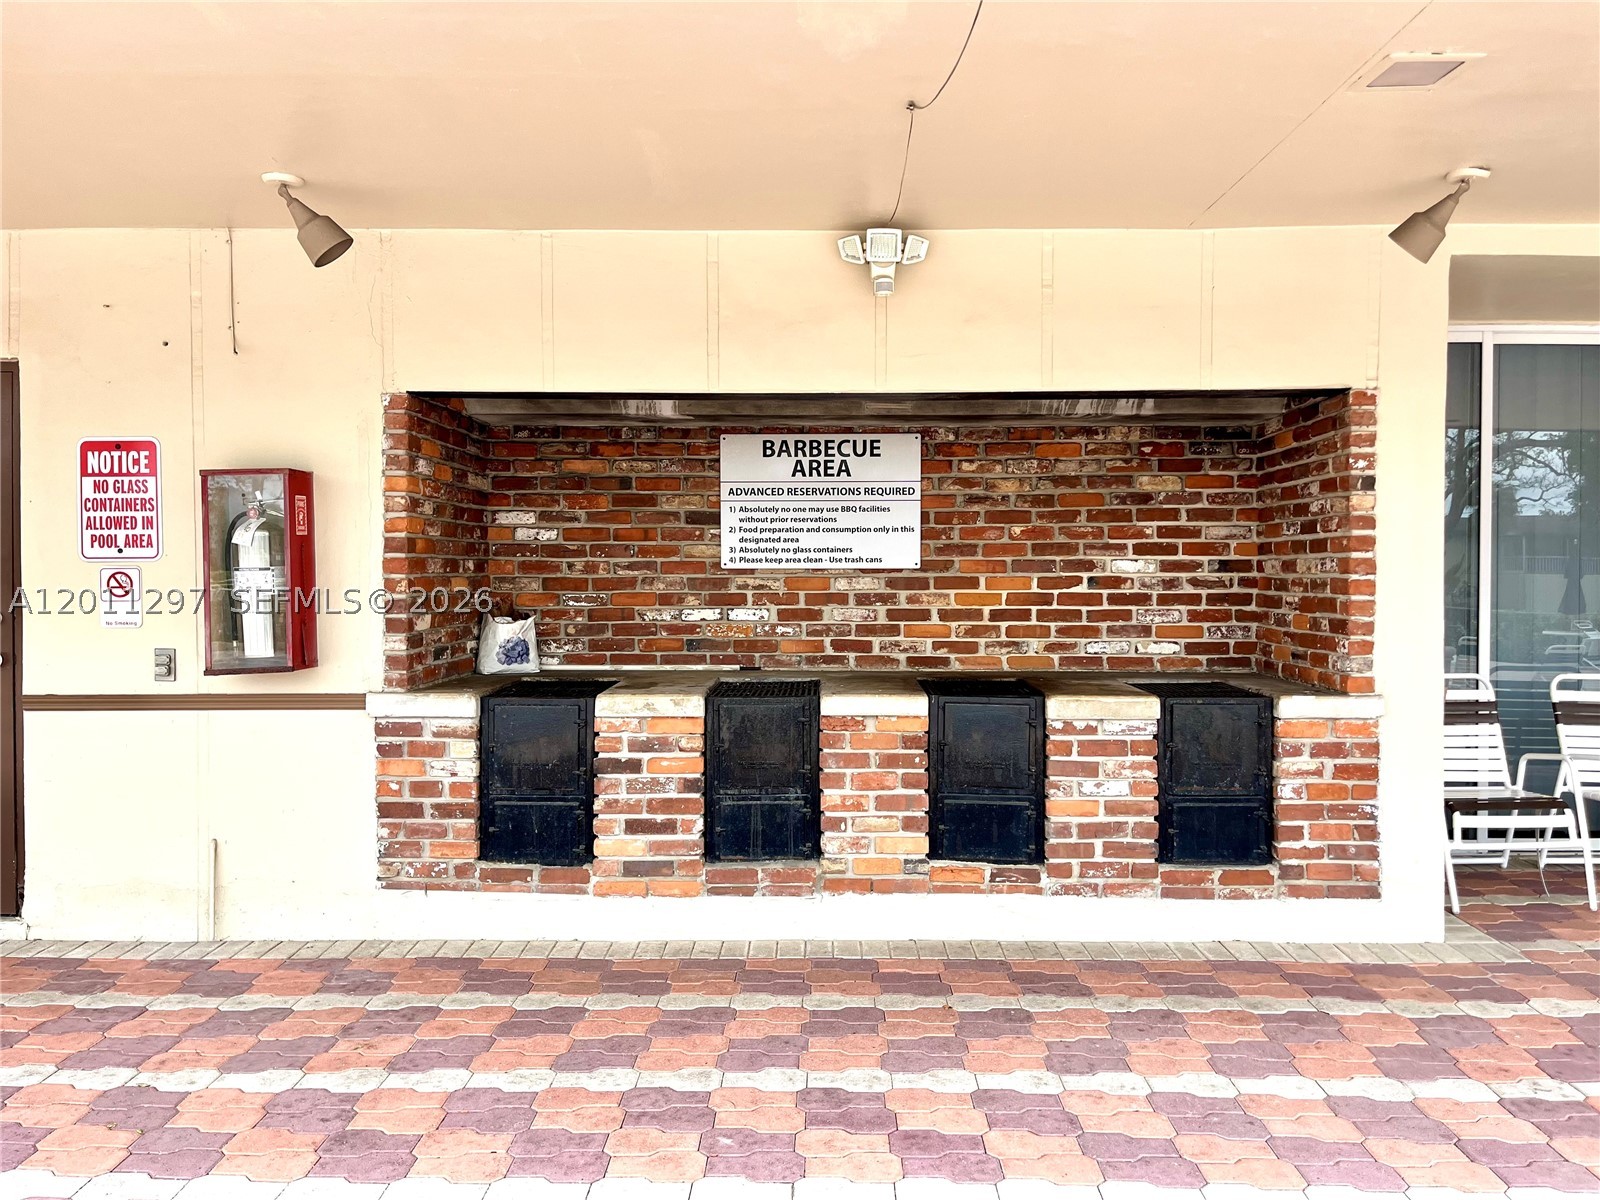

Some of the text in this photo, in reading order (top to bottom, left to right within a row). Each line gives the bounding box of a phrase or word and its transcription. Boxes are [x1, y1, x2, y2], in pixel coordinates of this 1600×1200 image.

[762, 439, 882, 458] BARBECUE
[87, 450, 150, 474] NOTICE
[790, 459, 852, 478] AREA
[93, 479, 149, 494] NO GLASS
[728, 487, 916, 497] ADVANCED RESERVATIONS REQUIRED
[84, 497, 155, 513] CONTAINERS
[728, 505, 737, 514] 1)
[738, 505, 780, 515] Absolutely
[808, 507, 825, 515] may
[840, 505, 858, 514] BBQ
[858, 505, 891, 513] facilities
[85, 515, 154, 531] ALLOWED IN
[738, 515, 838, 525] without prior reservations
[728, 525, 915, 535] 2) Food preparation and consumption only in this
[90, 533, 154, 549] POOL AREA
[738, 535, 782, 545] designated
[728, 546, 737, 554] 3)
[738, 545, 780, 555] Absolutely
[792, 545, 812, 555] glass
[812, 545, 853, 553] containers
[728, 556, 737, 564] 4)
[738, 556, 764, 564] Please
[764, 556, 784, 565] keep
[829, 556, 843, 564] Use
[844, 555, 864, 563] trash
